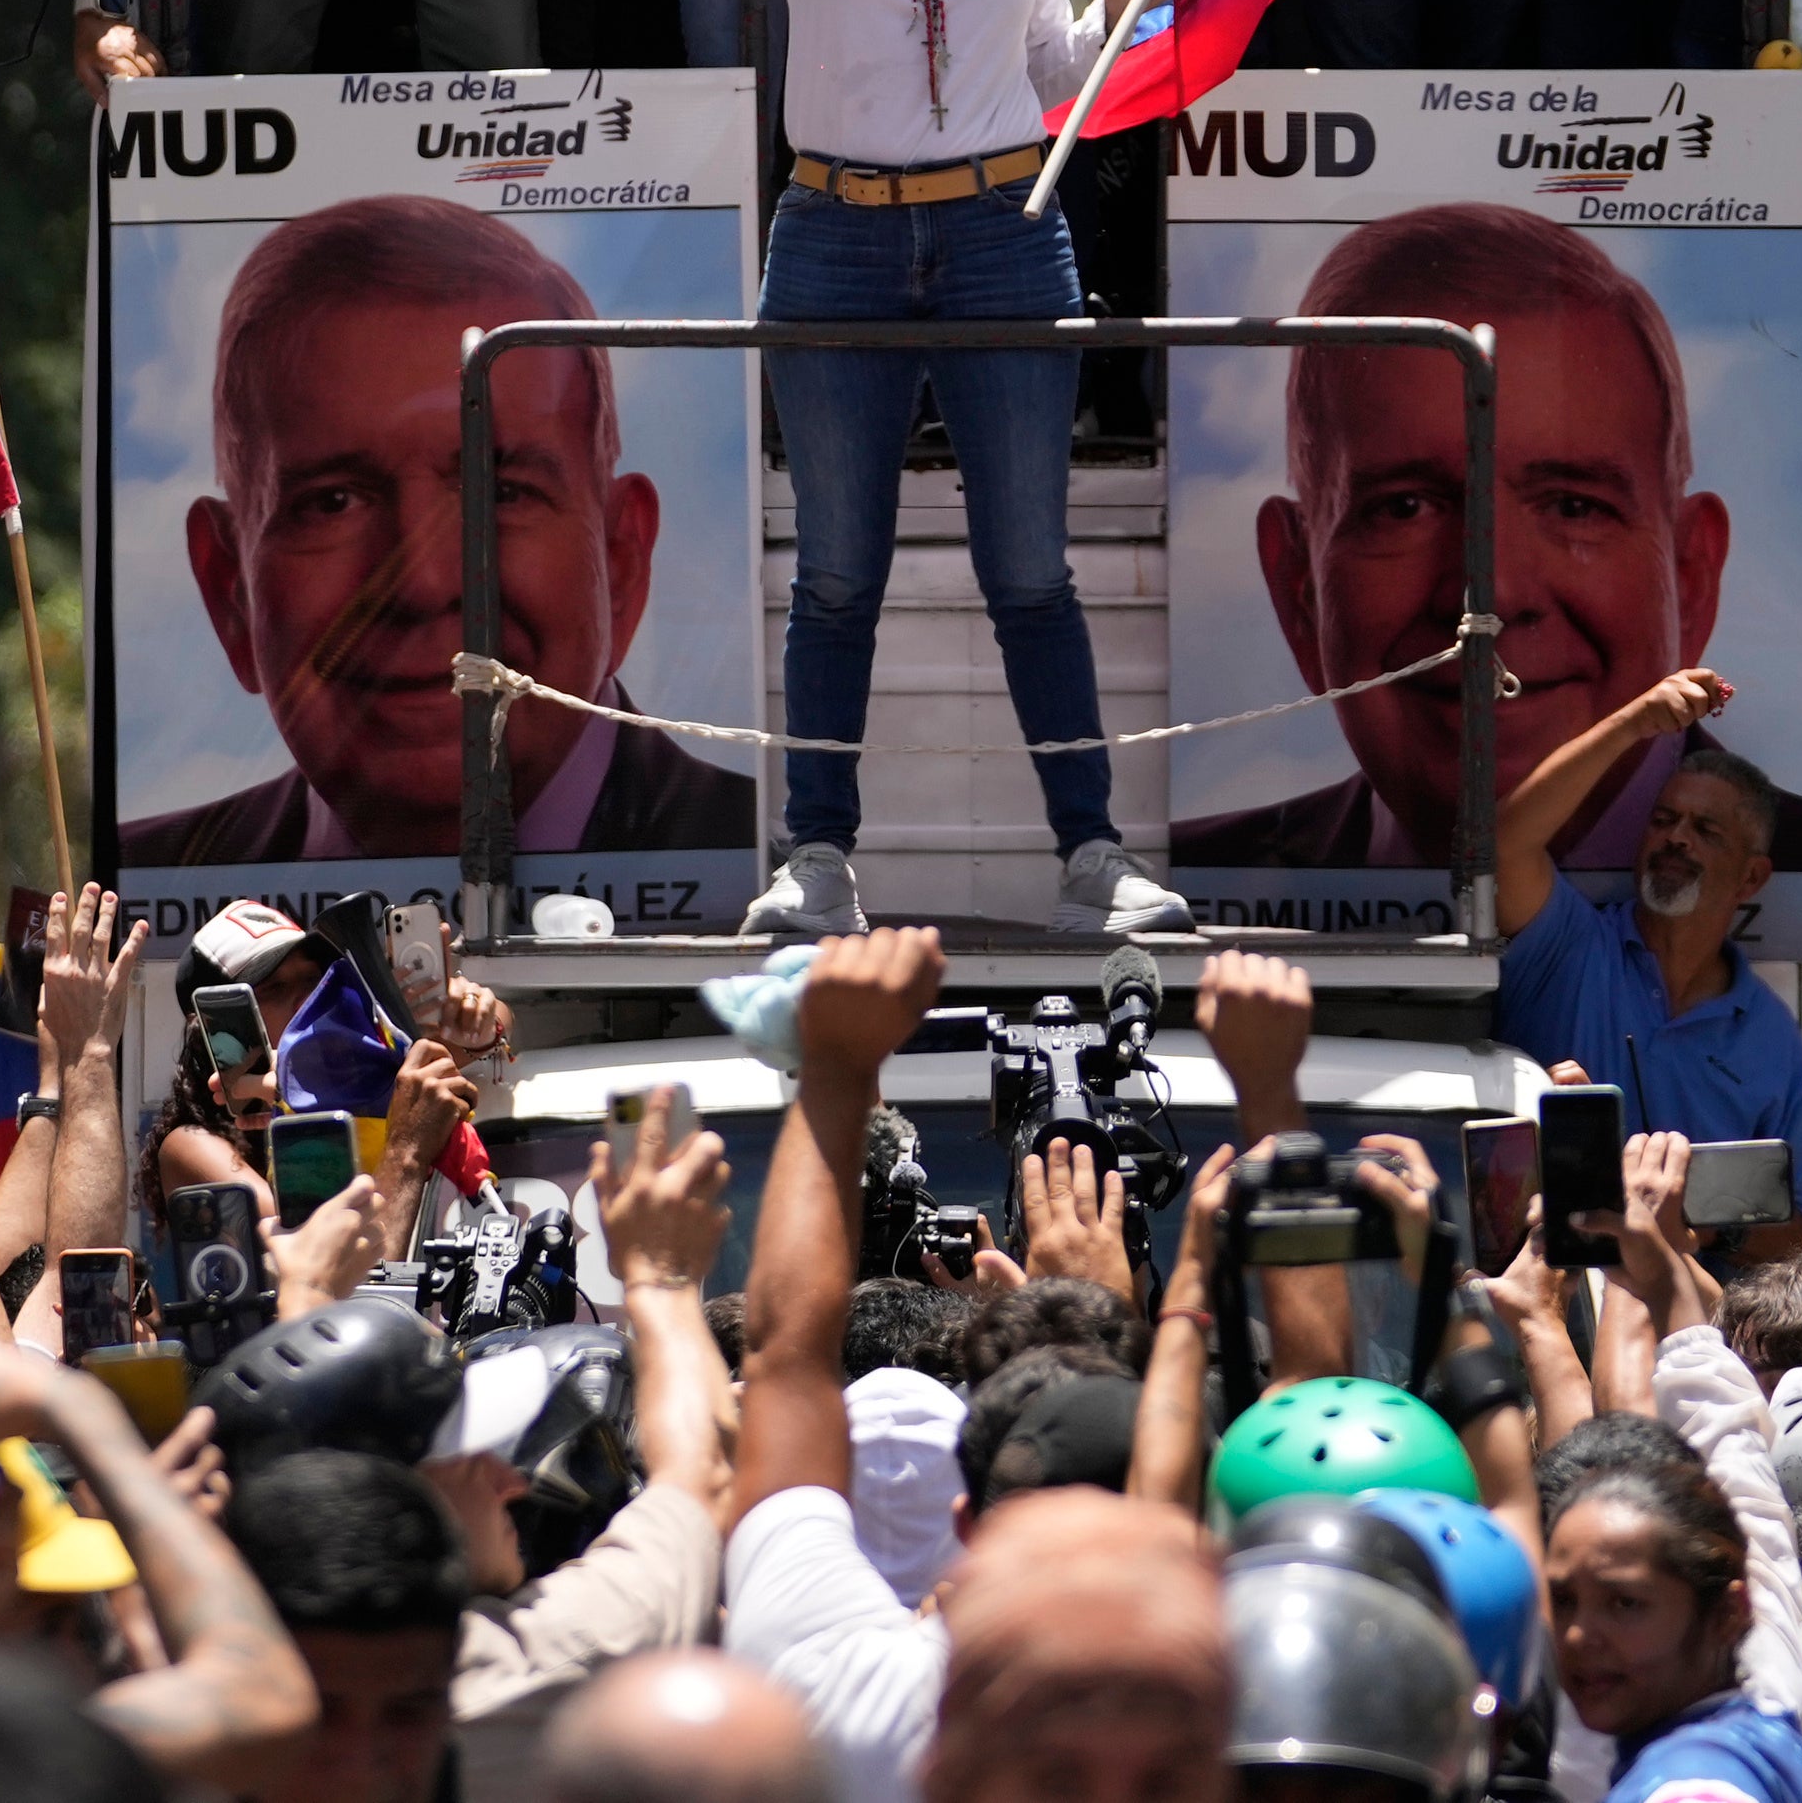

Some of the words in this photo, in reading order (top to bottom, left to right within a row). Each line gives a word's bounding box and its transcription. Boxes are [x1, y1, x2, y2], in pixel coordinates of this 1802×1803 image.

[340, 74, 435, 104] Mesa
[1420, 82, 1516, 111] Mesa
[108, 107, 297, 179] MUD
[417, 120, 588, 159] Unidad
[1166, 110, 1377, 178] MUD
[1497, 133, 1669, 171] Unidad
[500, 179, 691, 207] Democrática
[1579, 196, 1769, 222] Democrática
